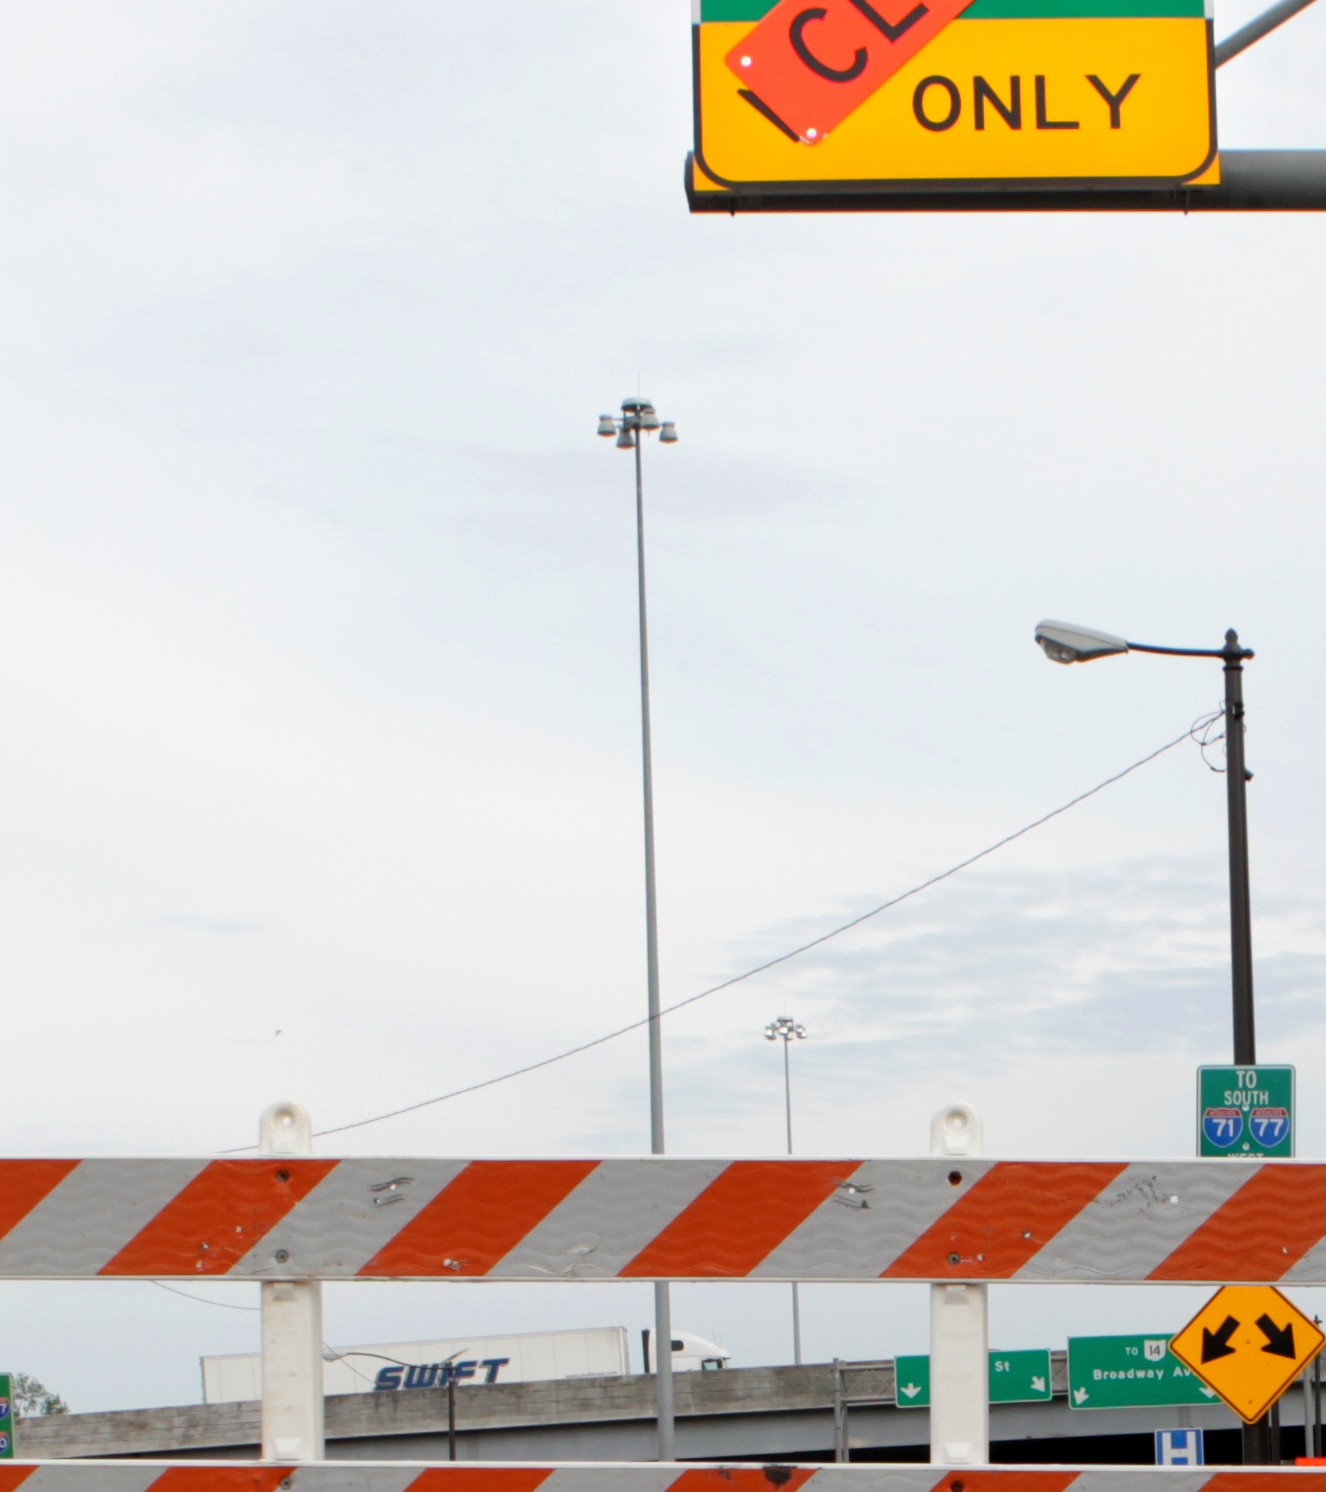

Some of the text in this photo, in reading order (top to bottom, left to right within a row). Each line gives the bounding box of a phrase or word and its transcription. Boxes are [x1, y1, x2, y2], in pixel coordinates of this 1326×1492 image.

[912, 73, 1142, 132] ONLY
[1236, 1070, 1257, 1088] TO
[1224, 1090, 1269, 1106] SOUTH
[1212, 1118, 1284, 1137] 71 77
[1125, 1345, 1161, 1356] TO 14
[373, 1357, 511, 1391] SWIFT
[994, 1360, 1010, 1372] St
[1093, 1368, 1164, 1380] Broadway
[1162, 1431, 1197, 1465] H
